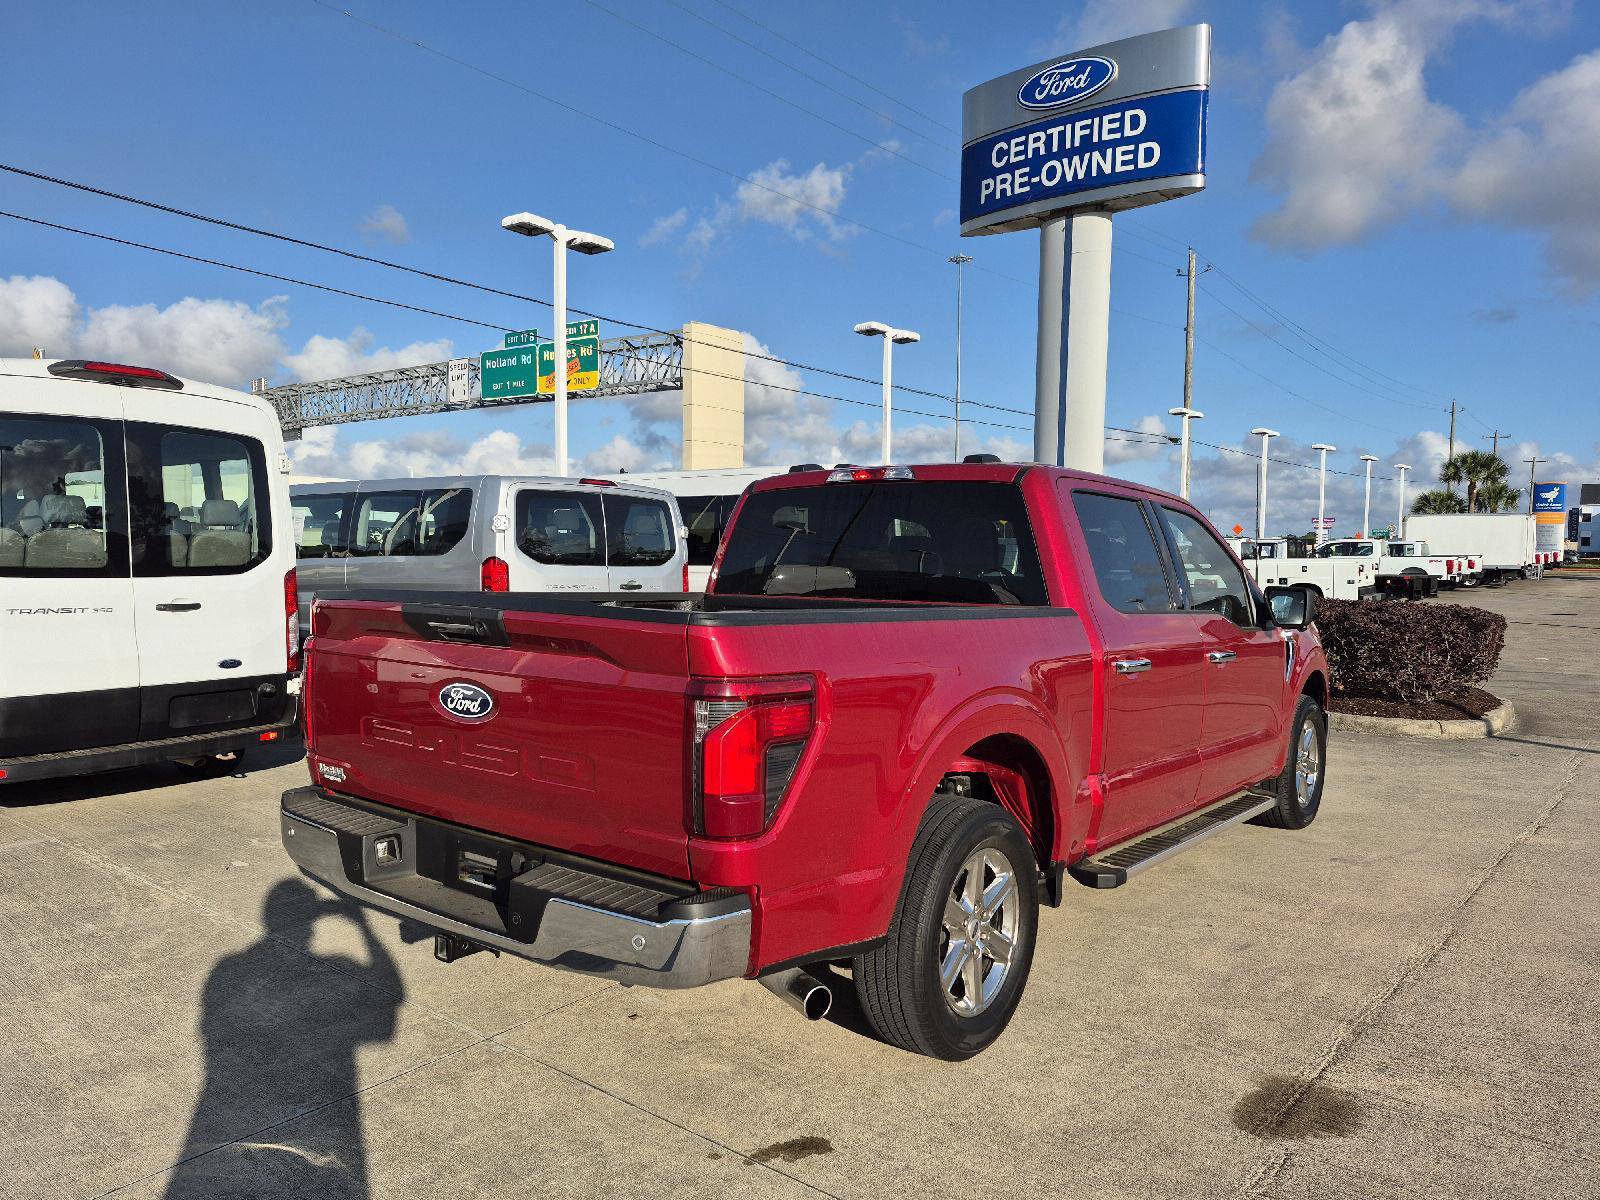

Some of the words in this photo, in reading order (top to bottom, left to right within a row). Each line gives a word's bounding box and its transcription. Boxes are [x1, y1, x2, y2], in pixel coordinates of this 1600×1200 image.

[1035, 64, 1091, 100] Ford
[991, 108, 1147, 169] CERTIFIED
[980, 141, 1161, 205] PRE-OWNED
[580, 324, 588, 334] 17
[589, 323, 596, 333] A
[520, 333, 528, 342] 17
[543, 348, 577, 361] Hues
[580, 344, 593, 356] Rd
[486, 355, 517, 369] Holland
[521, 353, 532, 365] Rd
[449, 363, 468, 372] SPEED
[451, 373, 466, 382] LIMIT
[573, 376, 591, 386] ONLY
[492, 382, 504, 390] EXIT
[506, 381, 511, 390] 1
[512, 380, 525, 388] MILE
[6, 607, 89, 615] TRANSIT
[446, 686, 483, 714] Ford
